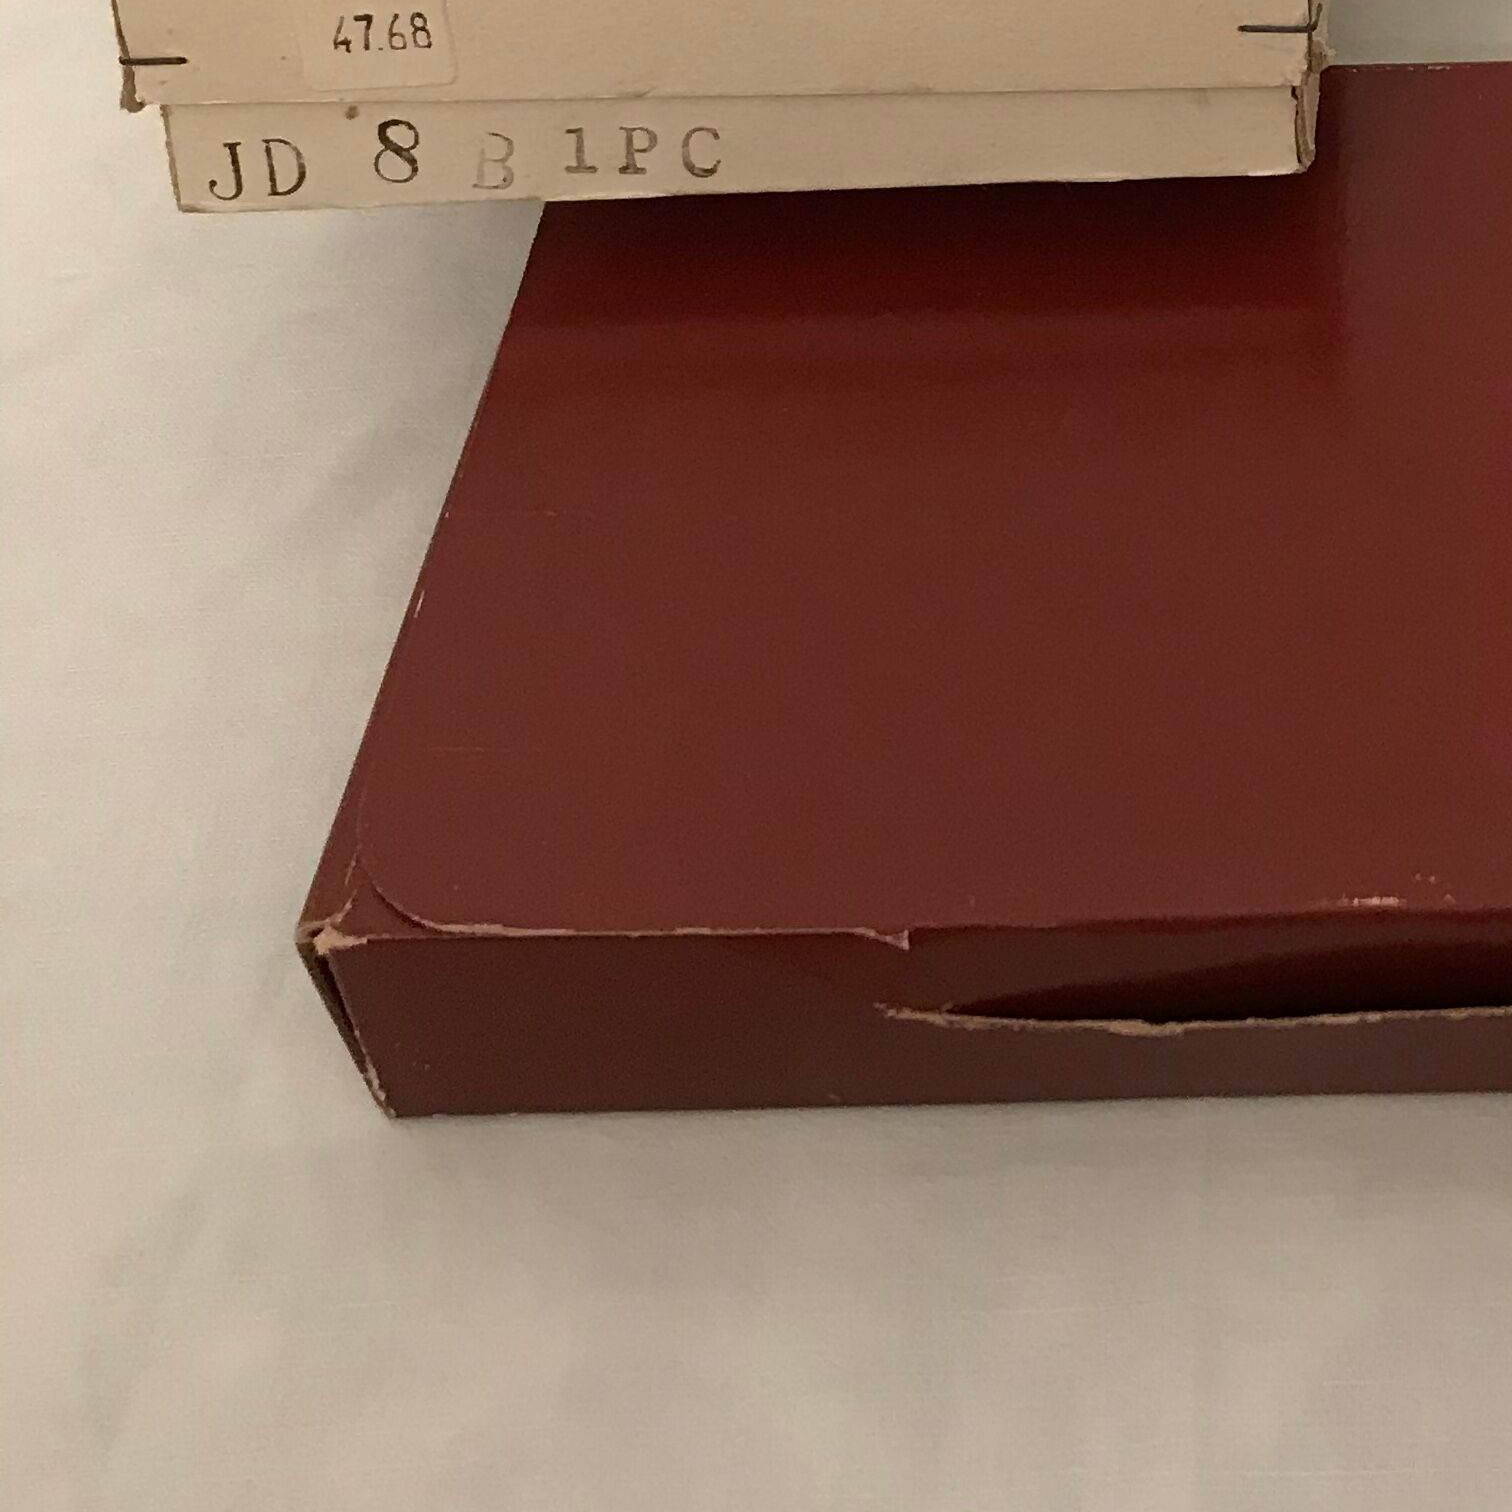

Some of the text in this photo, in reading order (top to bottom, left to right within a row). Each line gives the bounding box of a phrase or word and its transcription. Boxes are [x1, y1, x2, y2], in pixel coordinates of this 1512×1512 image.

[333, 12, 432, 53] 47.68
[208, 138, 307, 201] JD
[374, 119, 420, 184] 8
